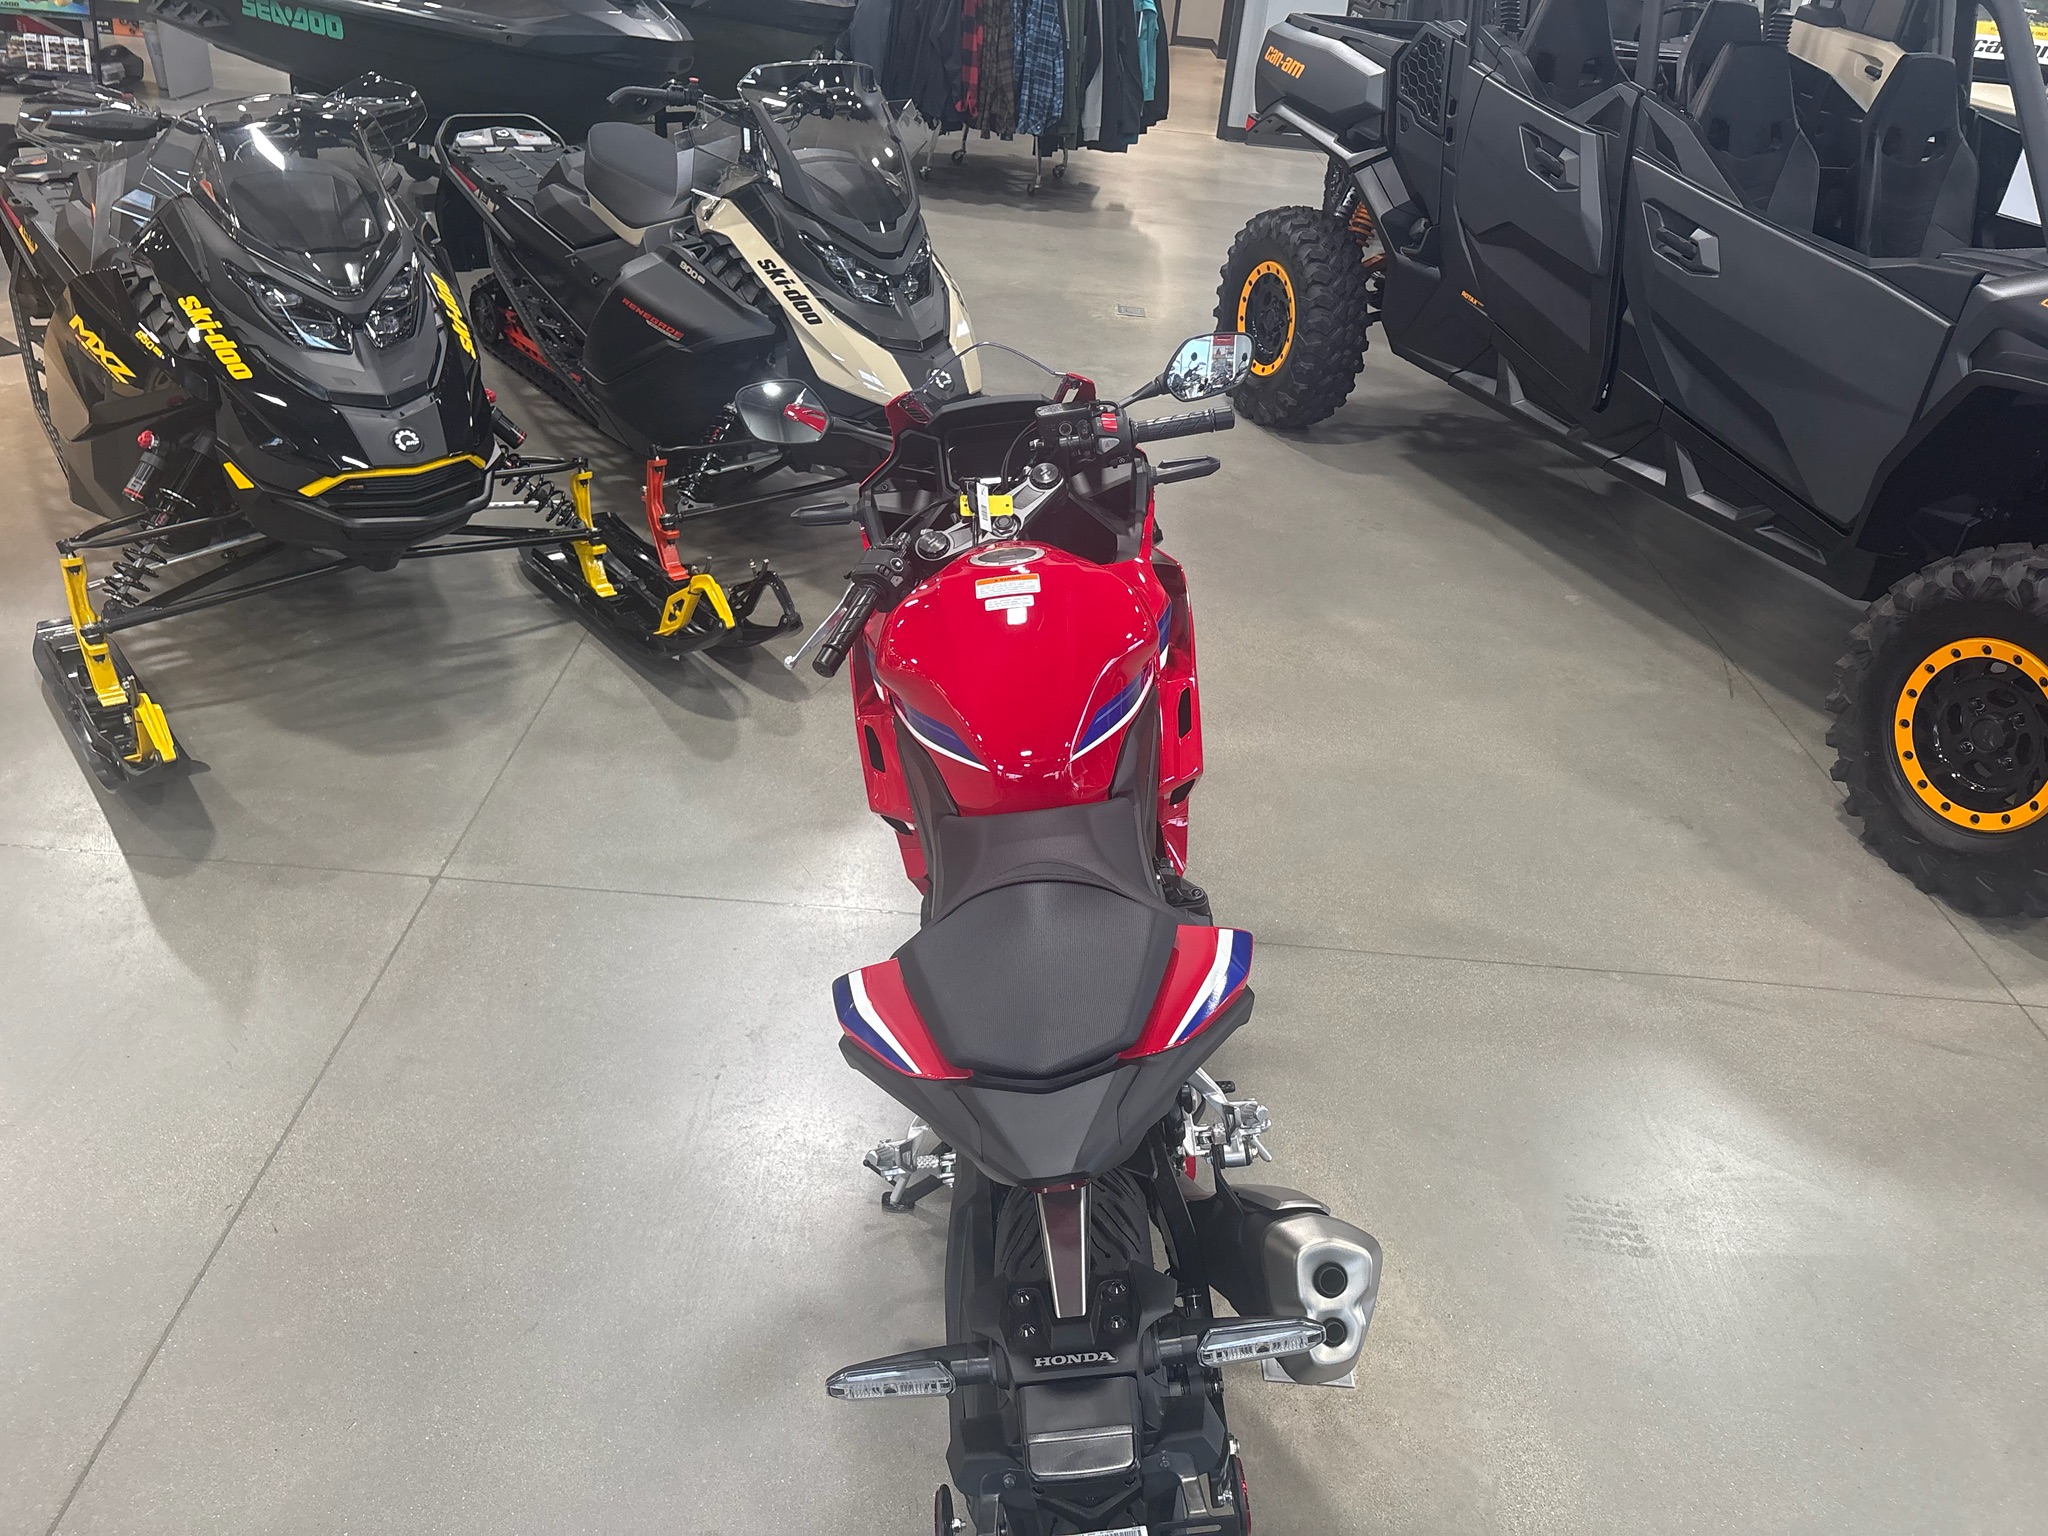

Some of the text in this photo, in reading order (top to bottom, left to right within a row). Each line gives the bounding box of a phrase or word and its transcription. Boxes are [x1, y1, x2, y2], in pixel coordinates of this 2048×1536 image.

[1264, 45, 1306, 79] can-am
[679, 260, 699, 281] 900
[757, 258, 823, 326] ski-doo
[621, 297, 685, 339] RENEGADE
[68, 314, 137, 385] MXZ
[134, 330, 155, 351] 850
[177, 295, 253, 380] ski-doo
[1033, 1351, 1116, 1367] HONDA
